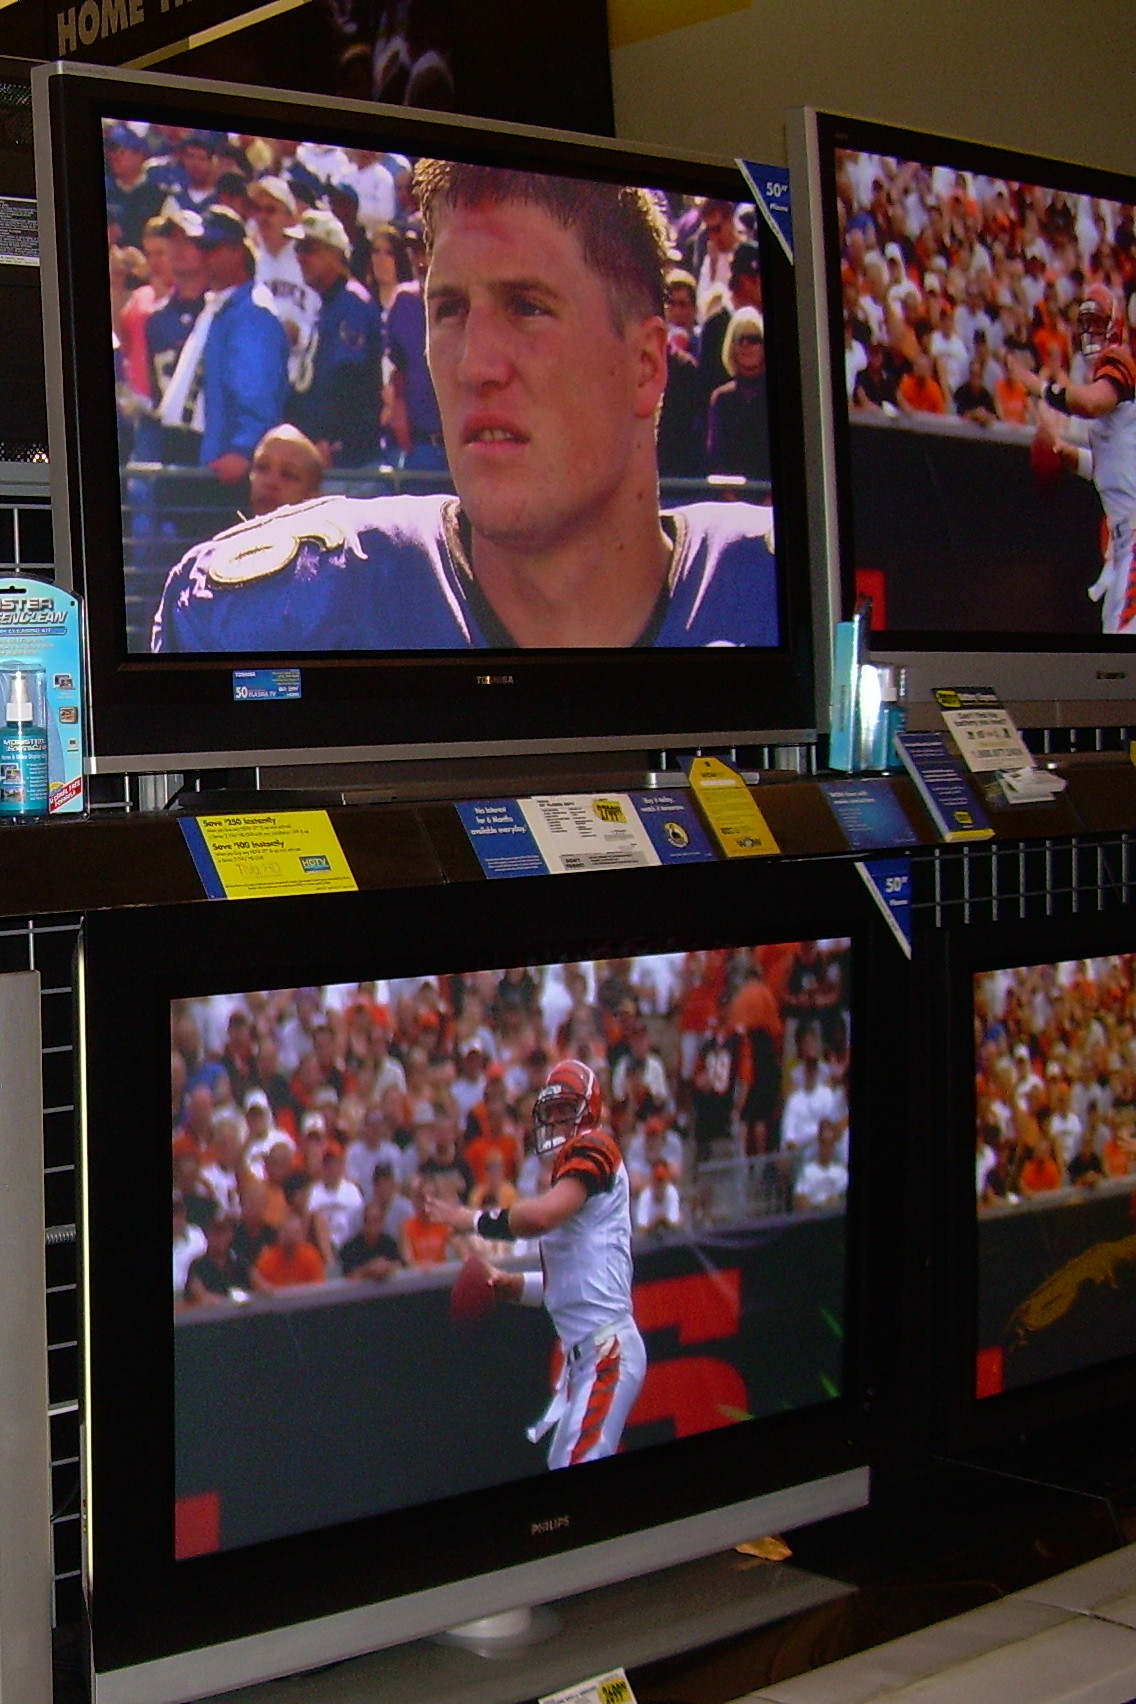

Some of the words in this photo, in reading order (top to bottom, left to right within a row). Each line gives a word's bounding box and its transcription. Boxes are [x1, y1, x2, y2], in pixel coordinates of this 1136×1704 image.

[57, 0, 145, 57] HOME
[235, 686, 248, 699] 50
[203, 819, 223, 828] Save
[531, 1516, 570, 1535] PHILIPS
